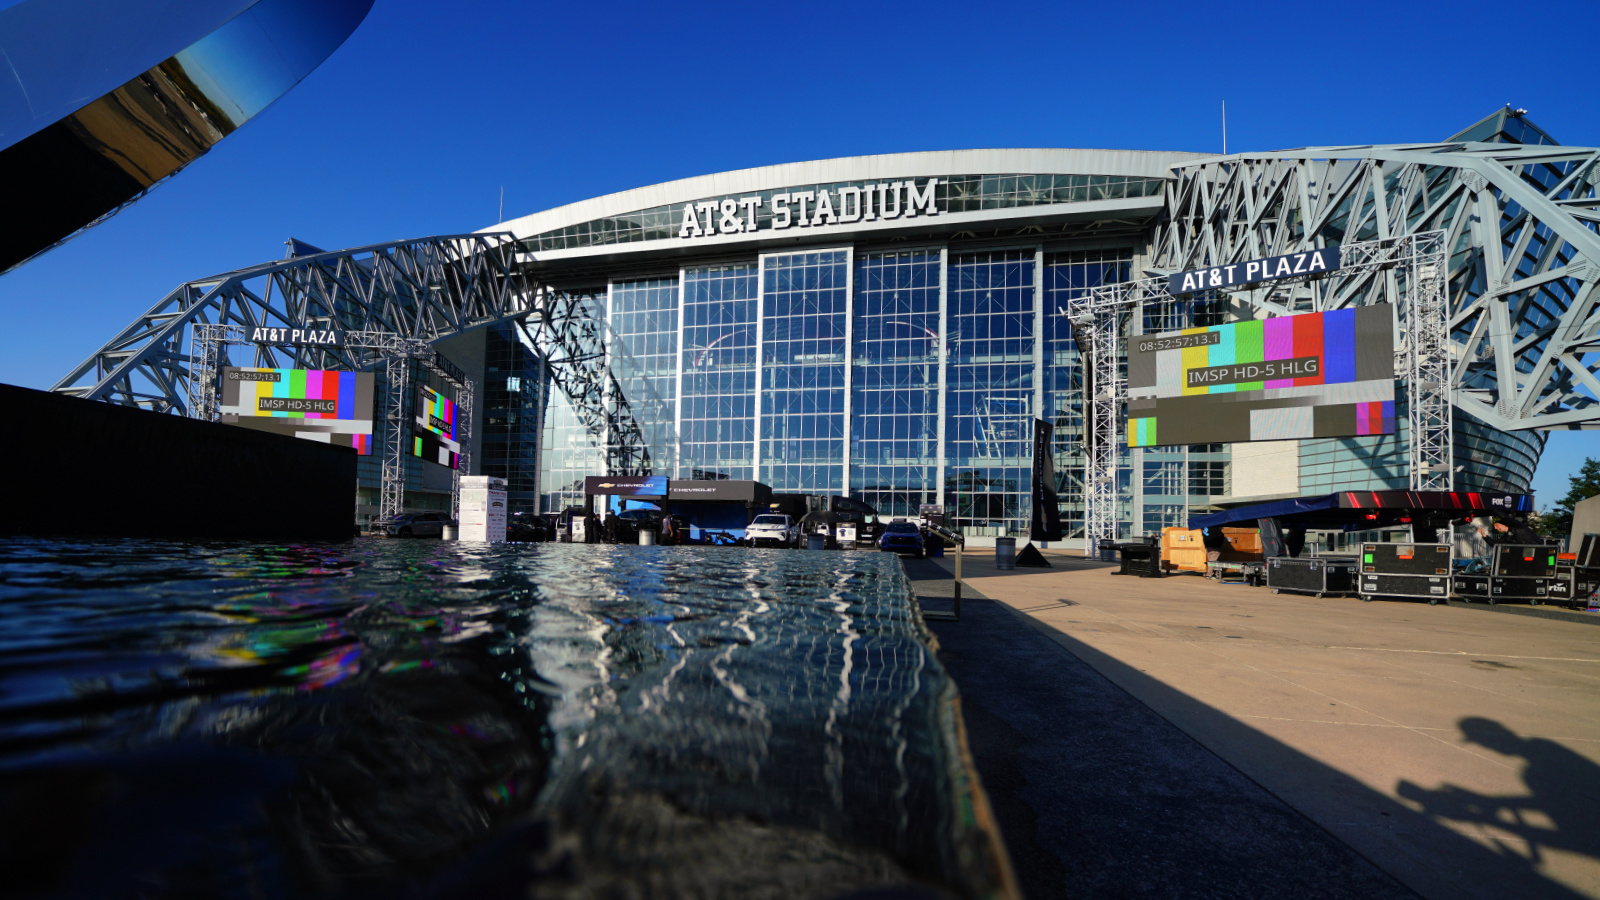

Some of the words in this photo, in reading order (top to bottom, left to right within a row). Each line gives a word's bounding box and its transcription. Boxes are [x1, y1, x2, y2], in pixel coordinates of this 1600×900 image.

[678, 195, 762, 238] AT&T
[771, 178, 939, 229] STADIUM
[1181, 264, 1238, 292] AT&T
[1246, 251, 1326, 281] PLAZA
[252, 327, 287, 343] AT&T
[292, 330, 337, 345] PLAZA
[1188, 368, 1229, 384] IMSP
[1233, 364, 1276, 380] HD-5
[1281, 360, 1318, 375] HLG
[259, 398, 285, 410] IMSP
[287, 401, 311, 411] HD-5
[313, 401, 335, 411] HLG
[1492, 497, 1504, 506] FOX
[1548, 583, 1567, 593] rtin
